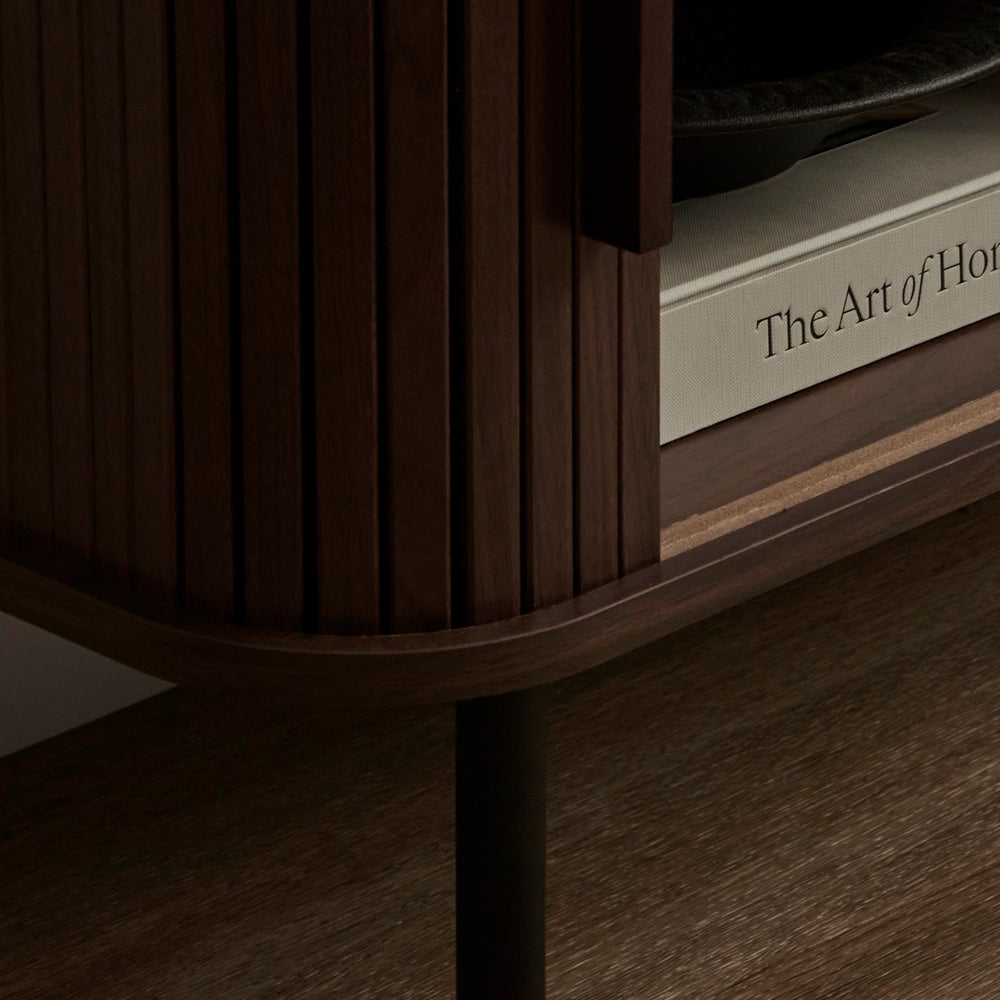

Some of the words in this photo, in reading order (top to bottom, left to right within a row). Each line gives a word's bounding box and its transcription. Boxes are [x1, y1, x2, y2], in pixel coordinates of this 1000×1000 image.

[755, 306, 829, 359] The
[835, 279, 892, 332] Art
[902, 254, 934, 317] of
